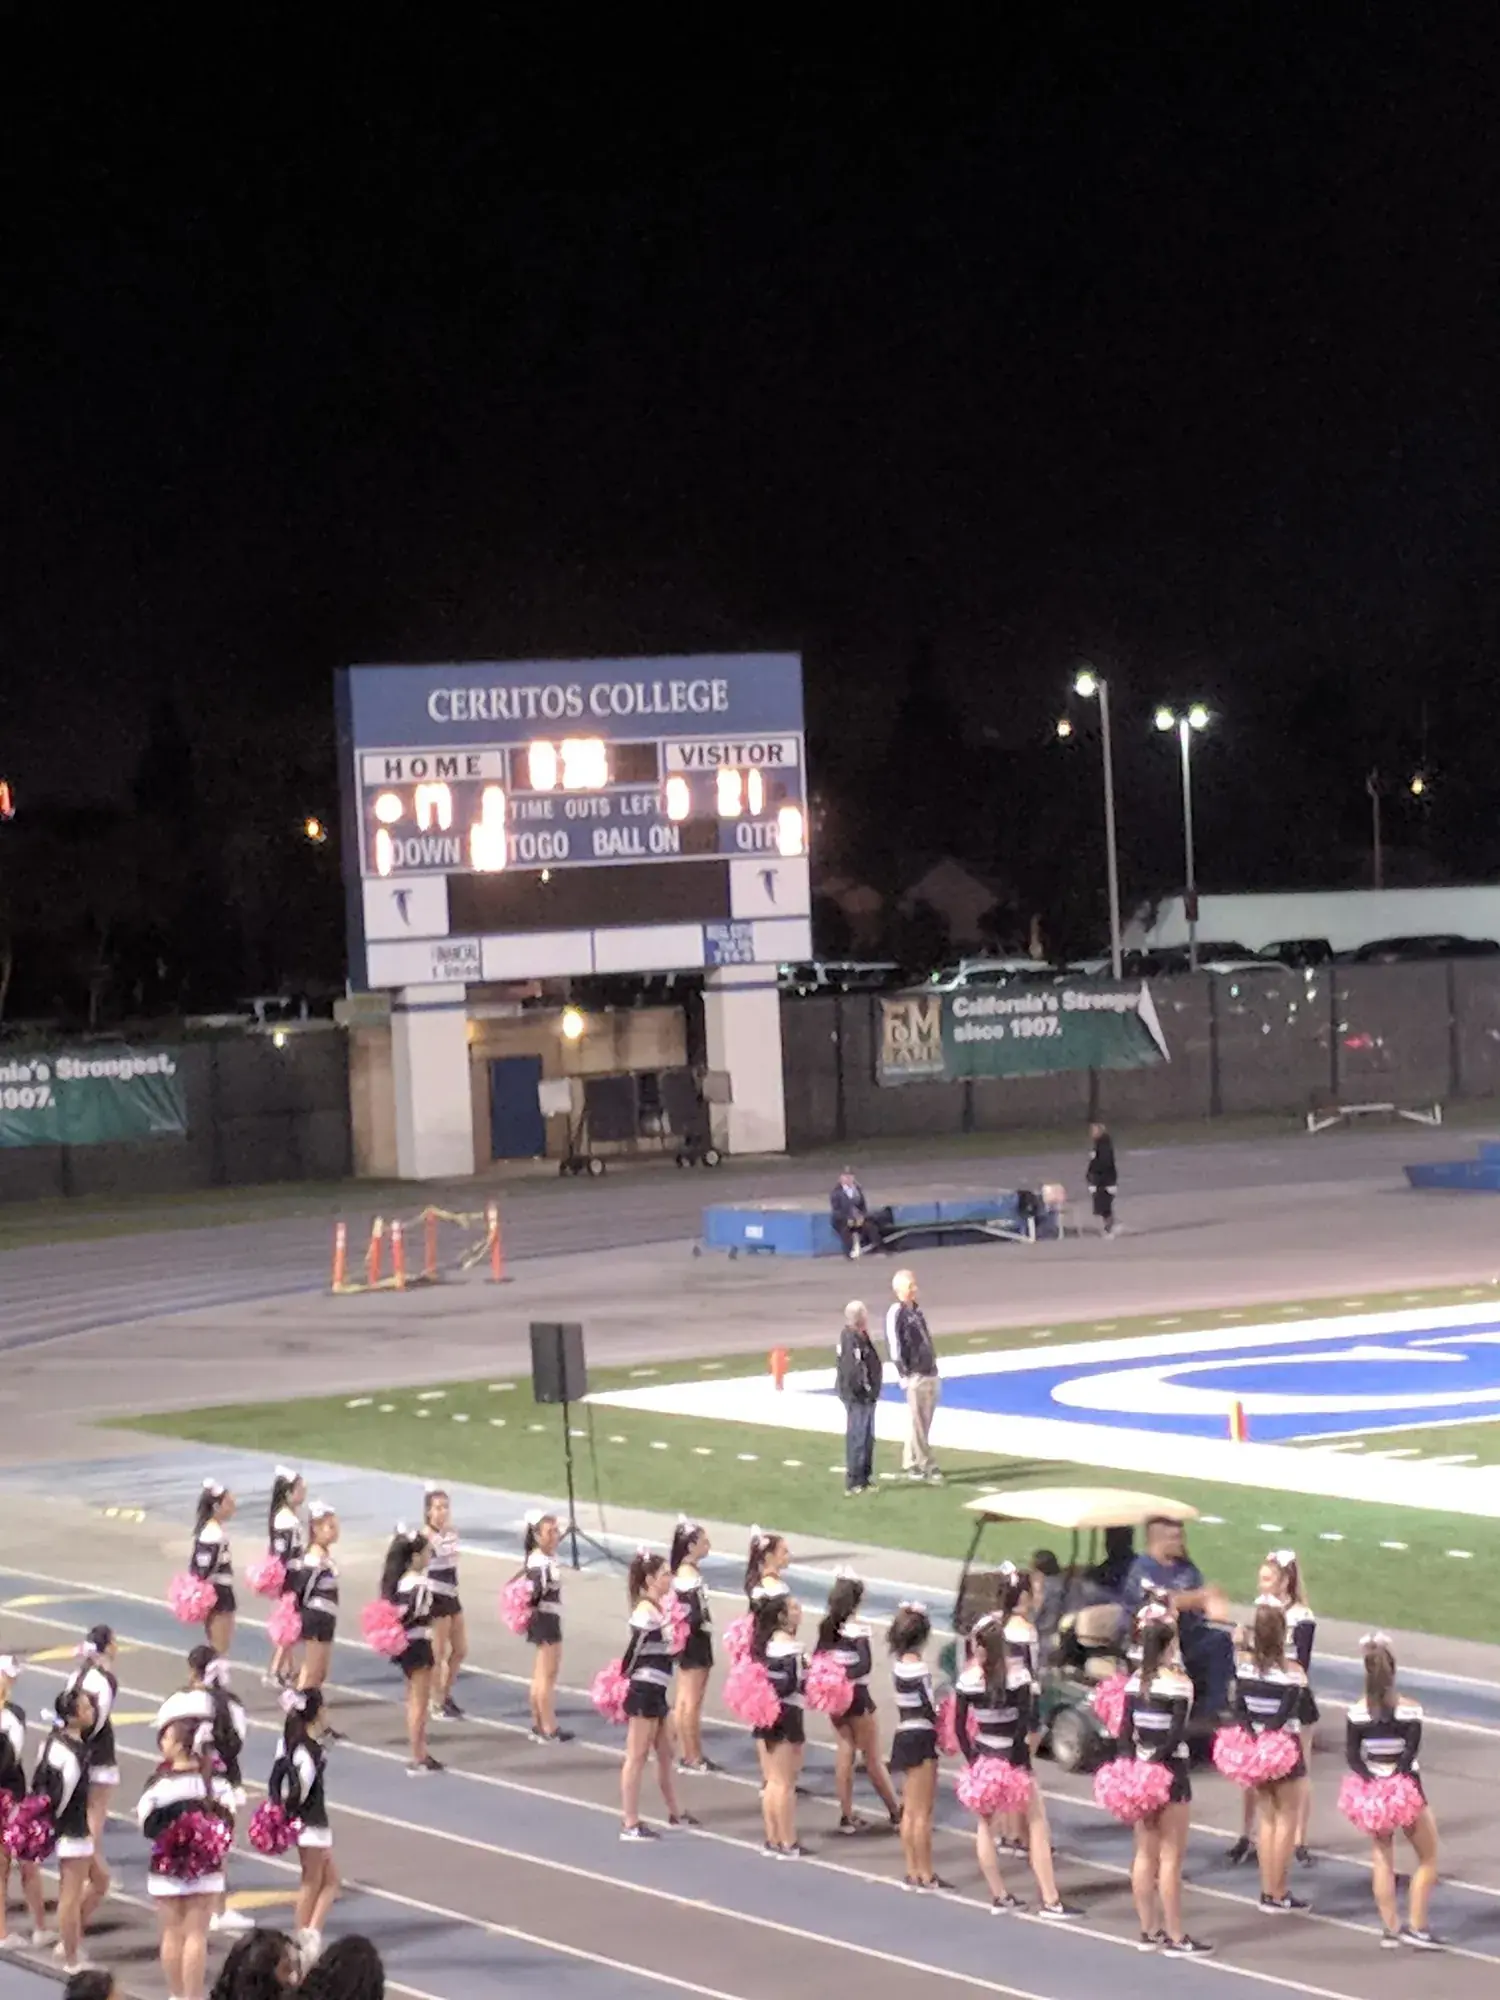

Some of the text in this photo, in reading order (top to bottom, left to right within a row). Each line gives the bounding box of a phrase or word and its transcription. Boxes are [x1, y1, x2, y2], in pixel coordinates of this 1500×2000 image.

[427, 679, 729, 723] CERRITOS COLLEGE
[384, 755, 482, 779] HOME
[679, 744, 783, 766] VISITOR
[510, 799, 554, 820] TIME
[564, 797, 611, 819] OUTS
[592, 823, 680, 857] BALL ON
